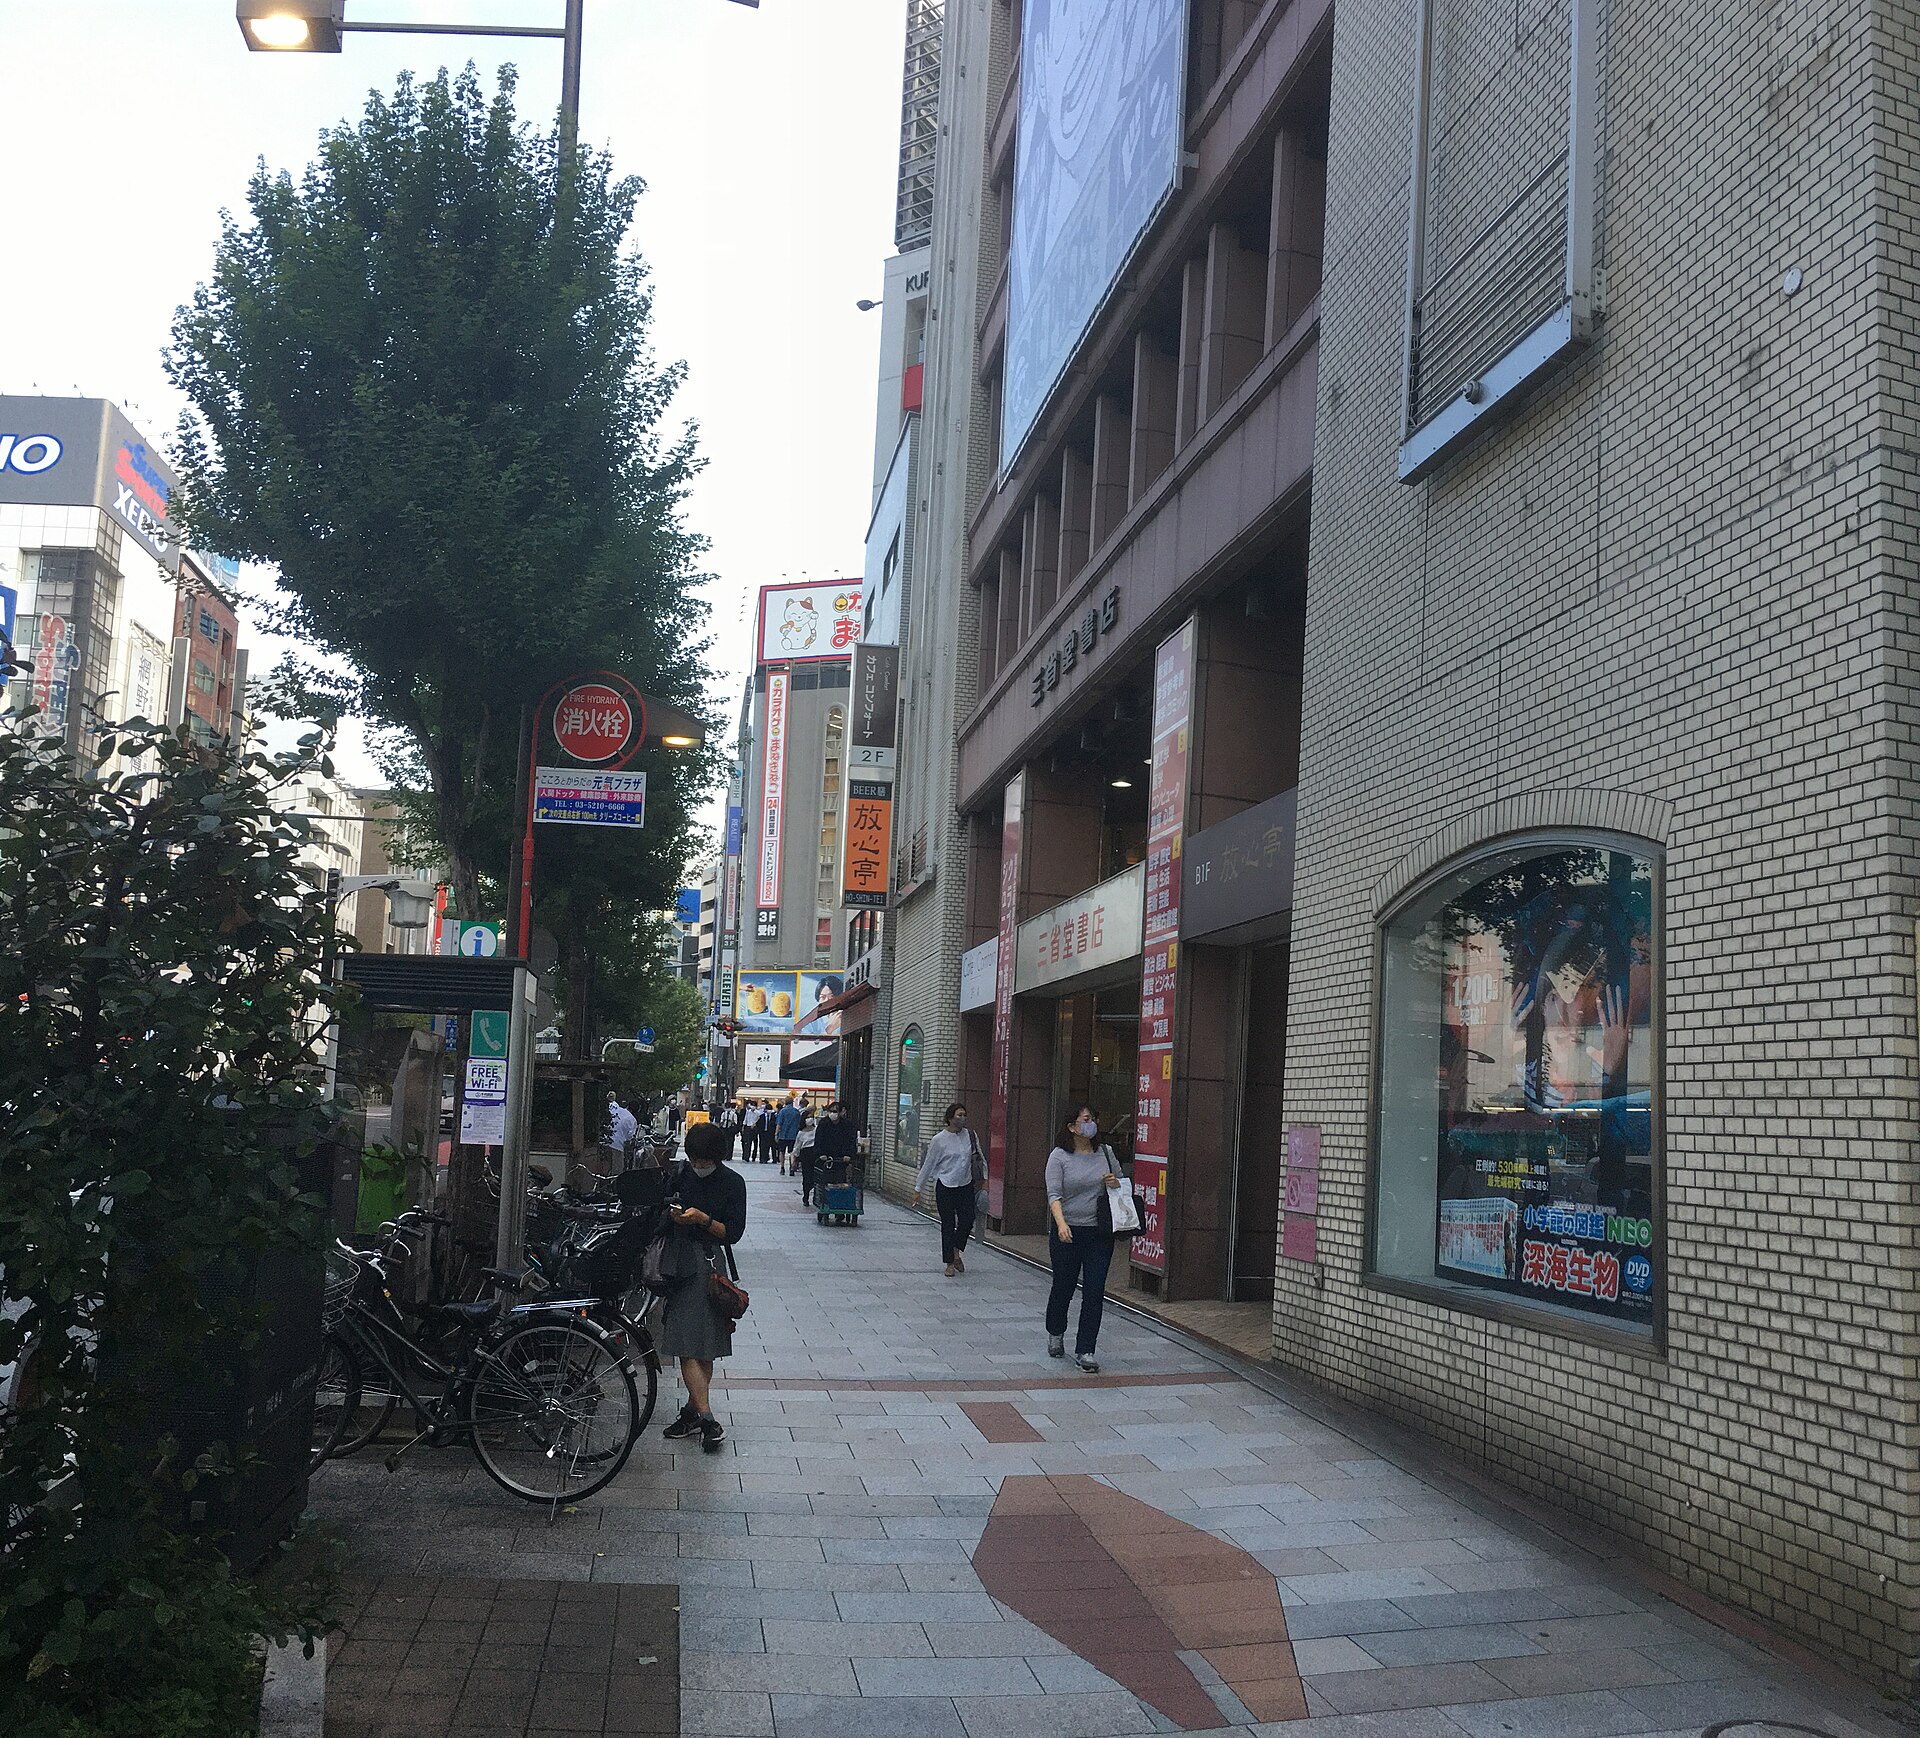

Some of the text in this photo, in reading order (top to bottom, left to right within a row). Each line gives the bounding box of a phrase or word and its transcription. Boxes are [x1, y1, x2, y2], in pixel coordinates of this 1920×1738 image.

[1030, 585, 1118, 708] 三省堂書店
[569, 695, 619, 704] FIRE HYDRANT
[771, 688, 783, 727] カラオケ
[862, 685, 876, 739] コンフォート
[561, 707, 625, 738] 消火栓
[861, 750, 884, 763] 2F
[592, 775, 642, 791] 元気プラザ
[852, 803, 883, 886] 放心亭
[1219, 824, 1284, 882] 放心亭
[1195, 861, 1211, 885] B1F
[845, 893, 884, 905] HO-SHIN-TEI
[758, 911, 777, 922] 3F
[757, 924, 777, 937] 受付
[1037, 904, 1105, 968] 三省堂書店
[1155, 973, 1175, 993] ビジネス
[1153, 1018, 1169, 1038] 文房具
[471, 1067, 498, 1078] FREE
[471, 1078, 498, 1089] Wi-Fi
[1523, 1204, 1605, 1240] 小学館の図鑑
[1607, 1216, 1652, 1247] NEO
[1522, 1240, 1620, 1301] 深海生物
[1627, 1261, 1650, 1278] DVD
[1632, 1277, 1645, 1288] つき
